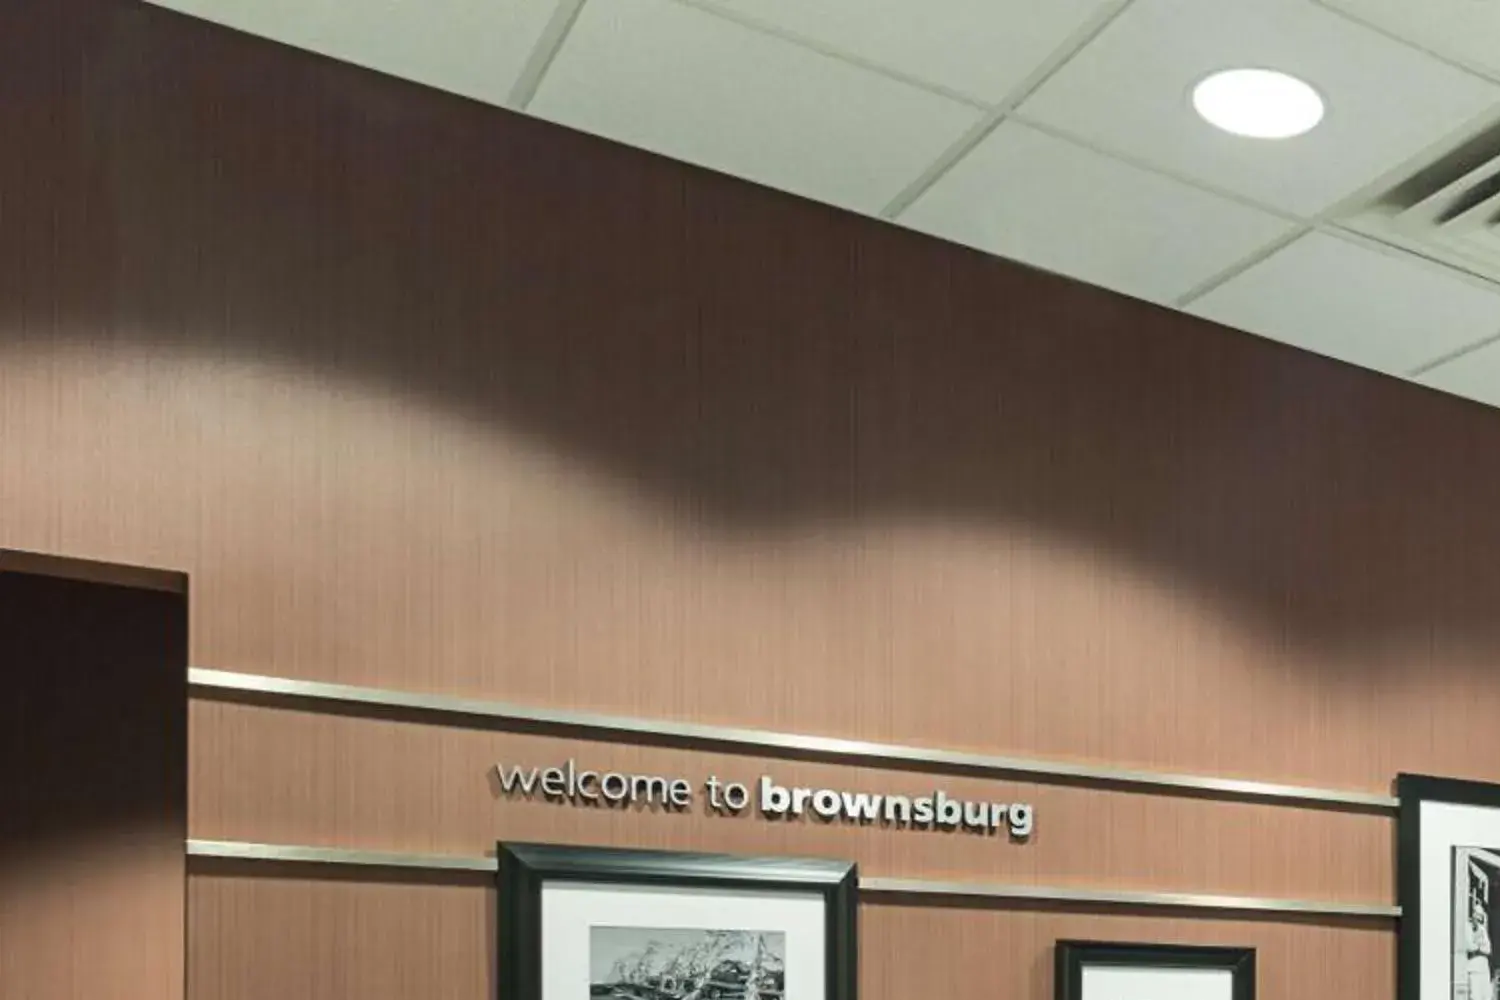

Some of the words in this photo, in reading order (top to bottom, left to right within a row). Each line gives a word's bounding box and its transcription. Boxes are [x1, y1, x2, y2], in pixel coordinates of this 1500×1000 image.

[496, 758, 692, 806] welcome
[706, 775, 749, 810] to
[760, 775, 1033, 836] brownsburg
